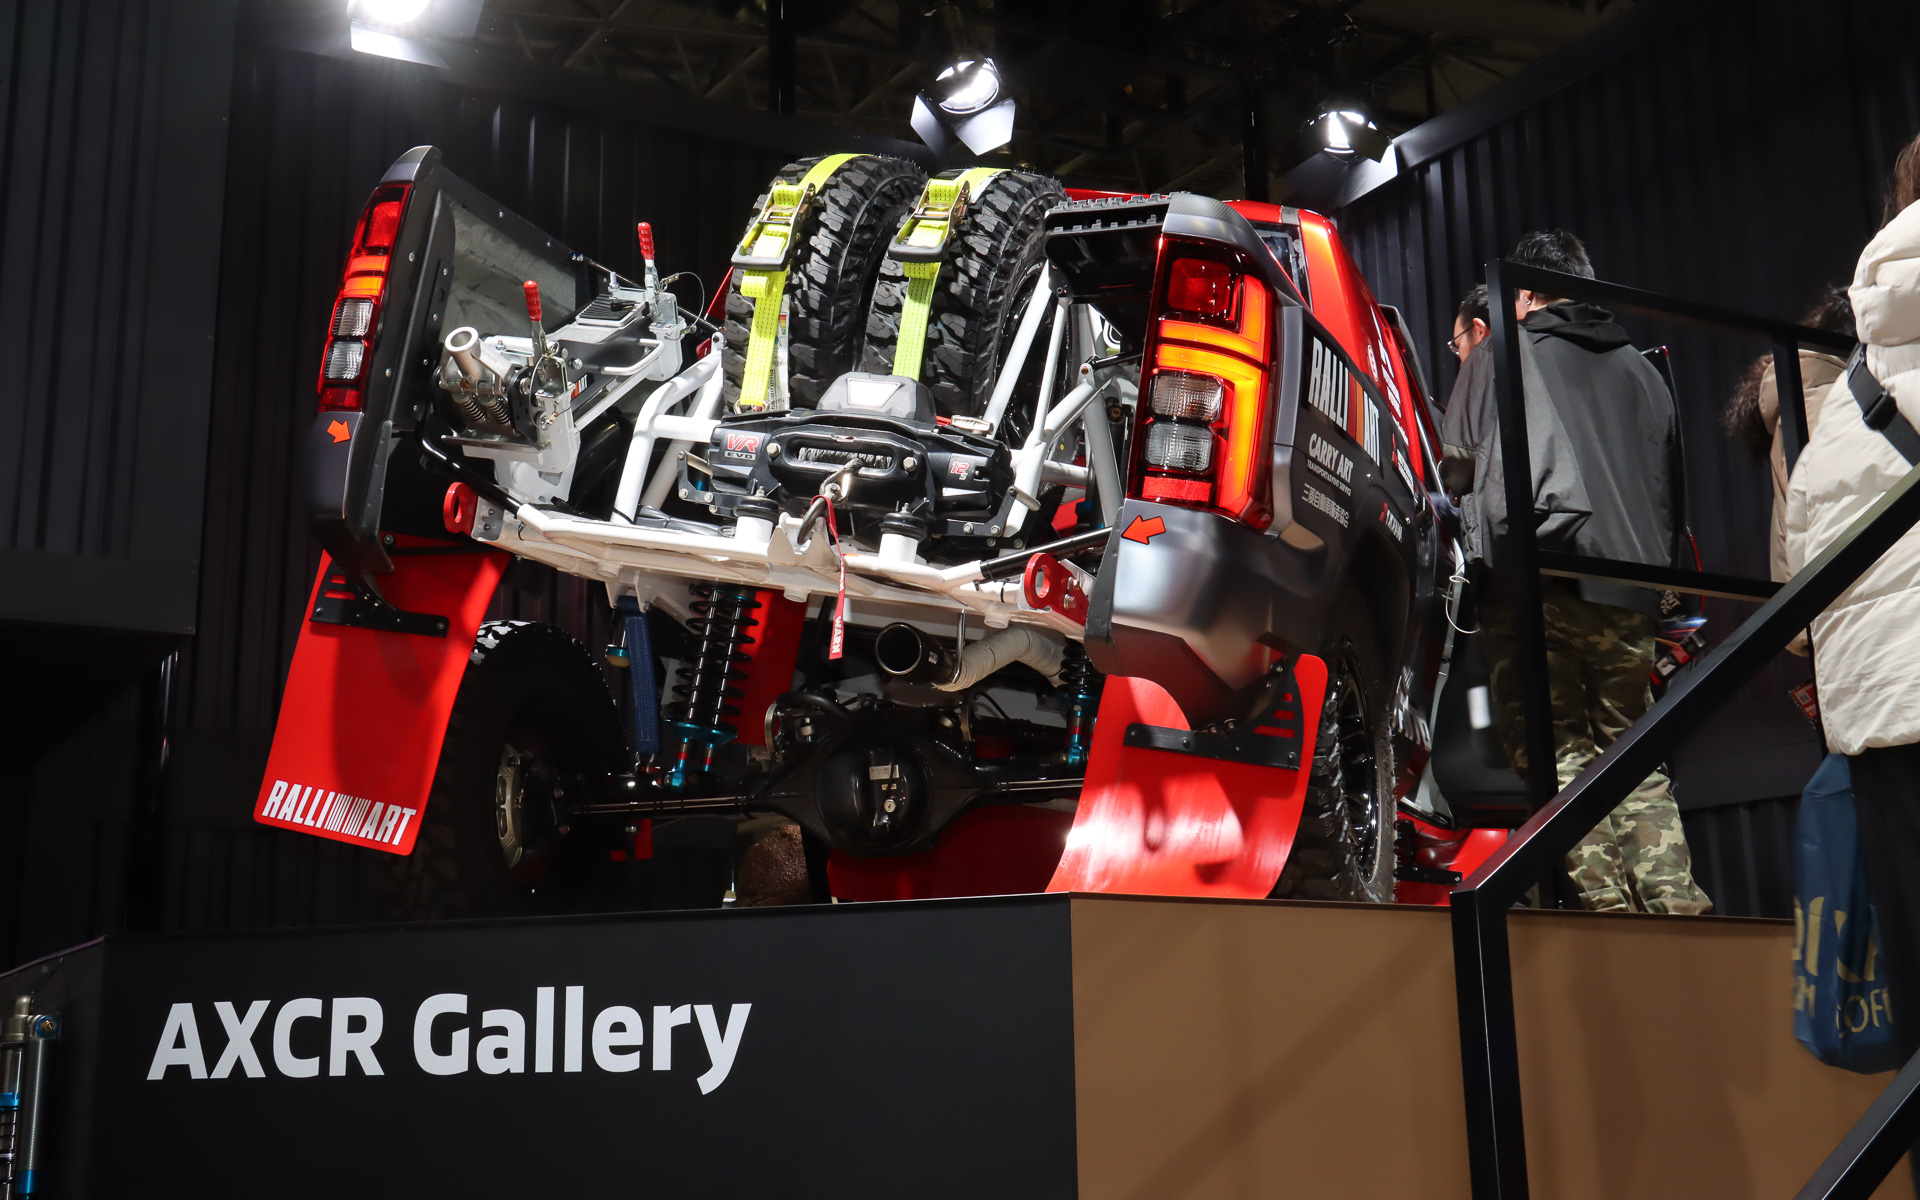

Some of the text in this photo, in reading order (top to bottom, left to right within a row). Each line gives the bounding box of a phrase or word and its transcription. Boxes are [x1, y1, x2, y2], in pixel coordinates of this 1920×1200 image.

[728, 434, 759, 453] VR
[1308, 433, 1354, 484] CARRY ART
[146, 985, 752, 1095] AXCR Gallery
